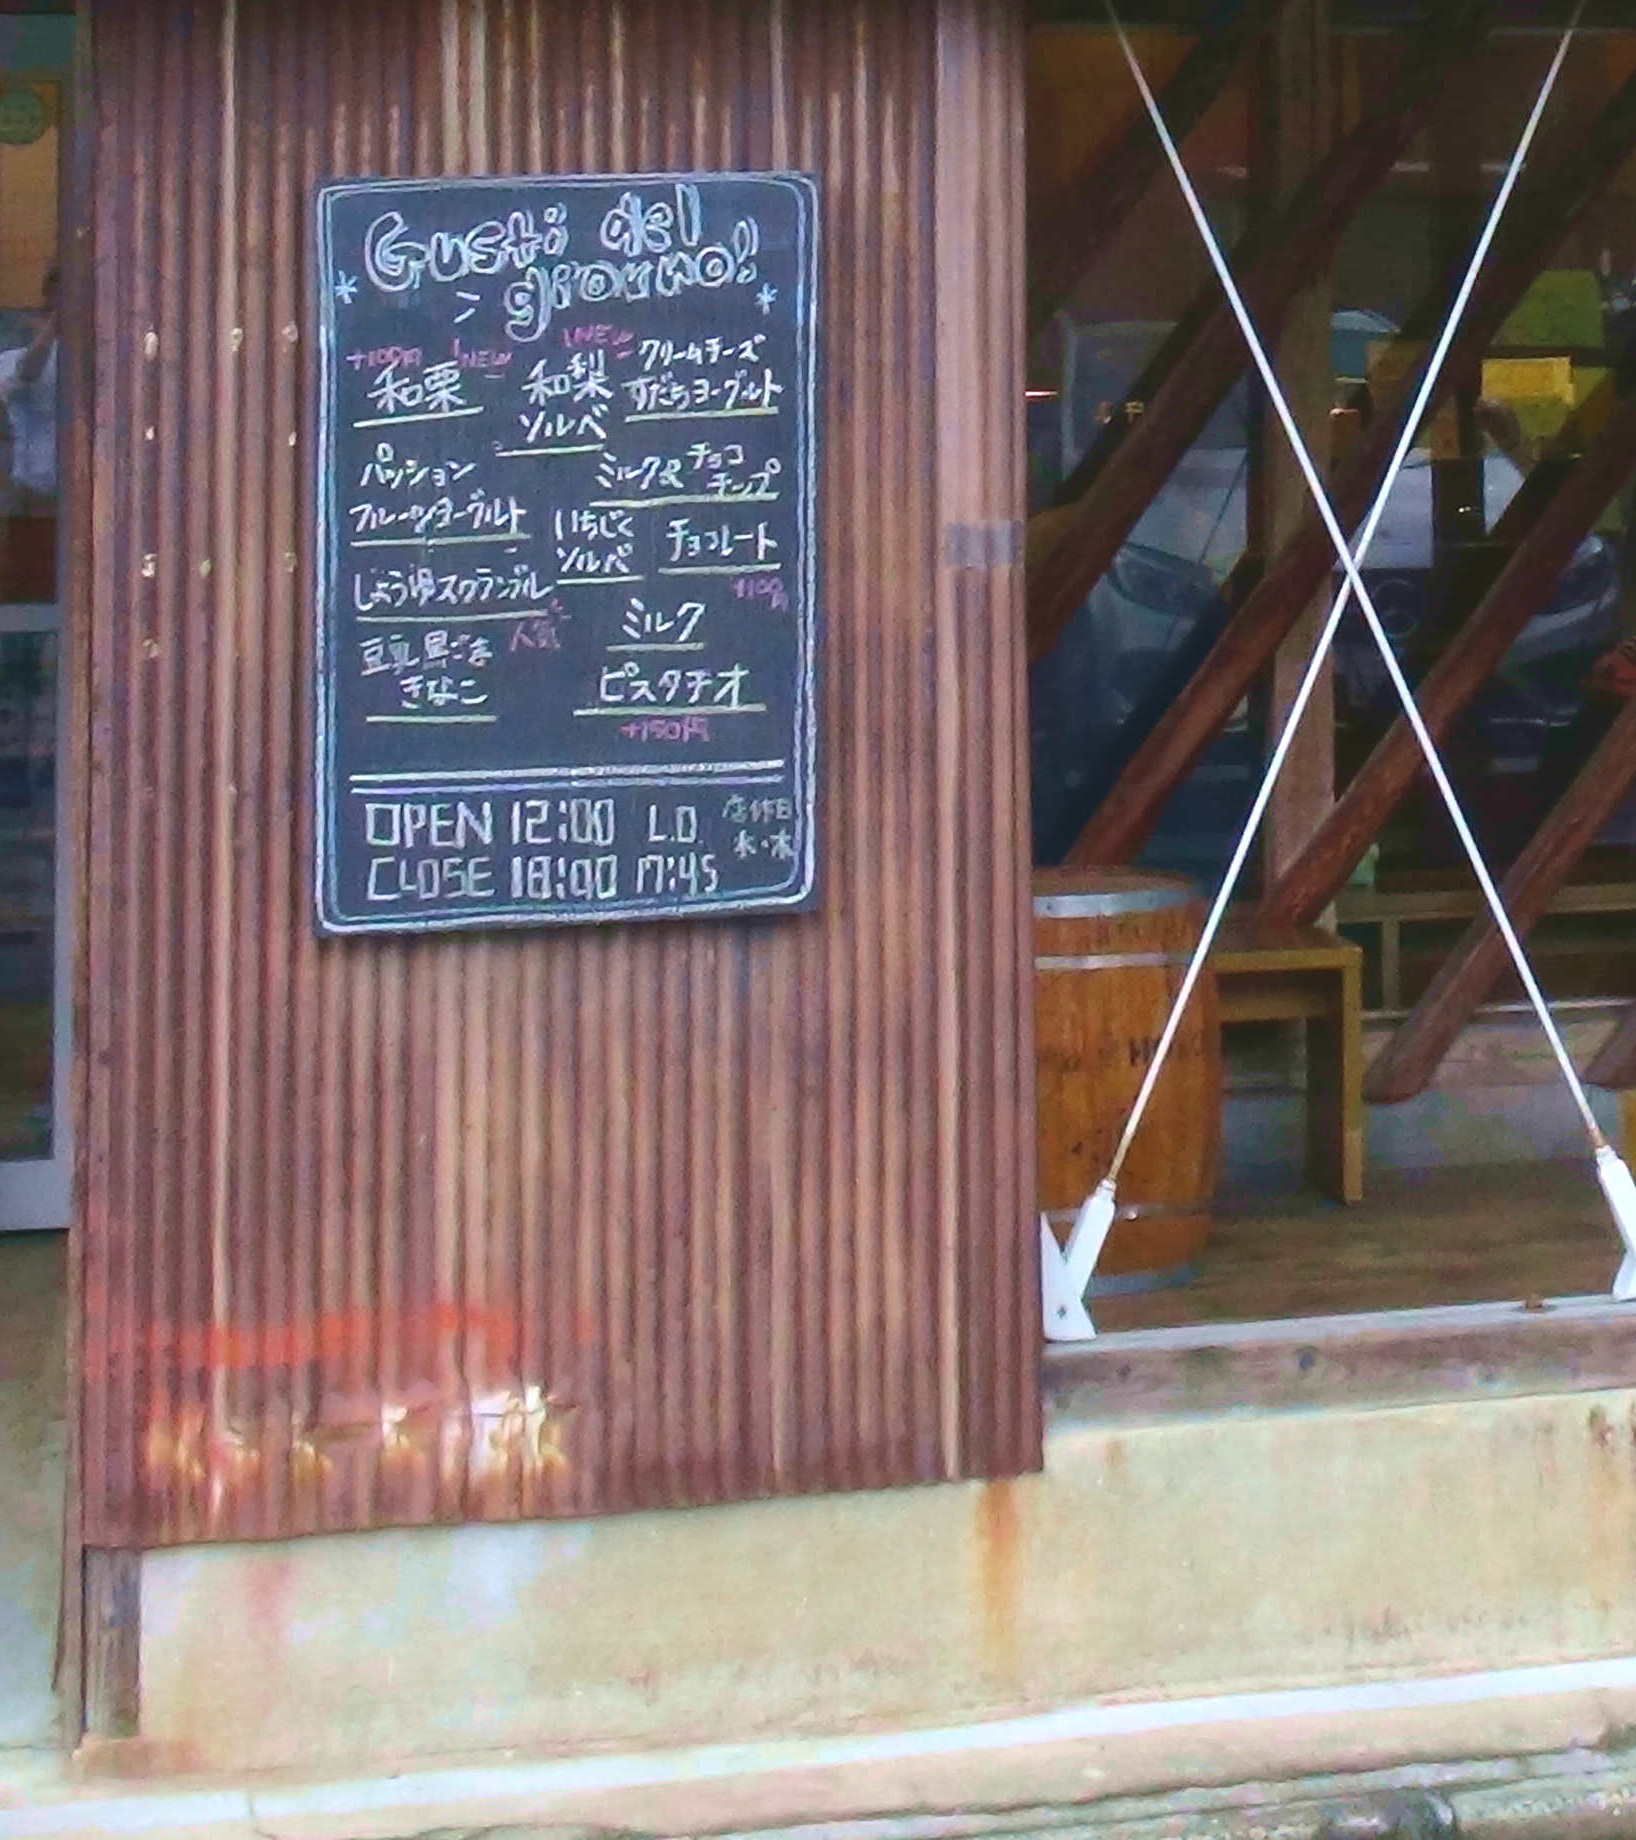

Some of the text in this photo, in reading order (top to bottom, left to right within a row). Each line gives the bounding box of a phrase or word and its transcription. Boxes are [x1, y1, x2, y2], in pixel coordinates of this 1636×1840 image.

[364, 183, 701, 291] Gusti del
[638, 334, 766, 371] クリームチーズ
[367, 360, 466, 413] 和栗
[521, 348, 613, 406] 和梨
[621, 368, 784, 410] すだちヨーグルト
[520, 404, 609, 443] ソルベ
[360, 442, 477, 489] パッション
[554, 509, 635, 541] いちじく
[666, 517, 778, 562] チョコレート
[622, 597, 706, 642] ミルク
[399, 675, 488, 709] きなこ
[600, 662, 750, 709] ピスタチオ
[365, 801, 493, 848] OPEN
[511, 798, 614, 846] 12:00
[367, 852, 718, 900] CLOSE 18:00 17:45
